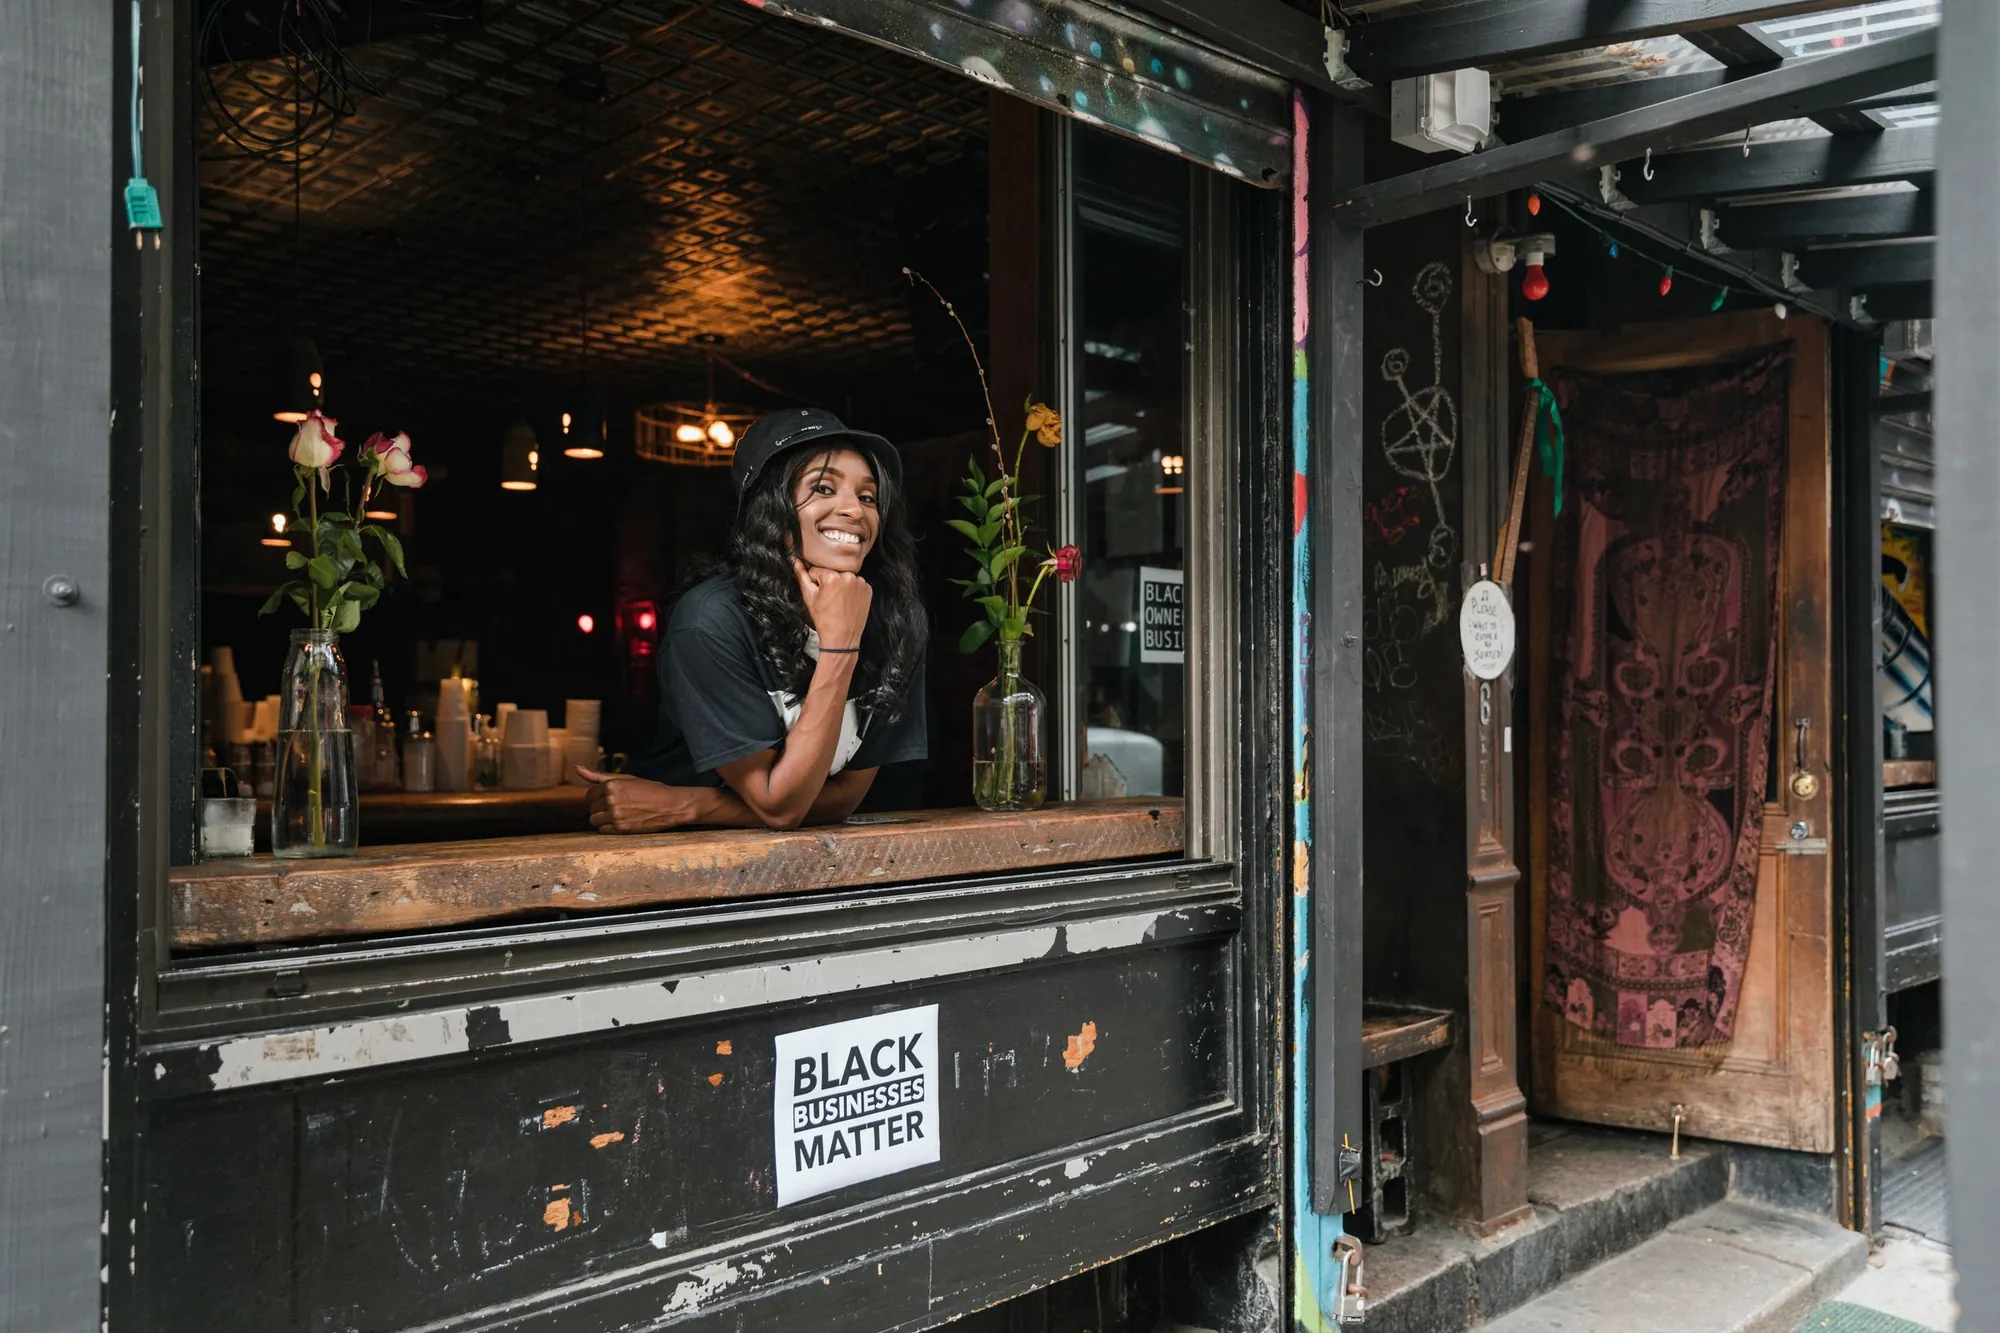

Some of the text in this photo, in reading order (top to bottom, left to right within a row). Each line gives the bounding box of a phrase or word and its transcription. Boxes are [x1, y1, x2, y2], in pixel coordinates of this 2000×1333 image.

[1146, 583, 1184, 603] BLAC
[1145, 606, 1184, 626] OWNE
[1471, 597, 1498, 617] PLEASE
[1146, 629, 1184, 648] BUSI
[793, 1032, 924, 1097] BLACK
[795, 1077, 924, 1130] BUSINESSES
[794, 1110, 925, 1172] MATTER
